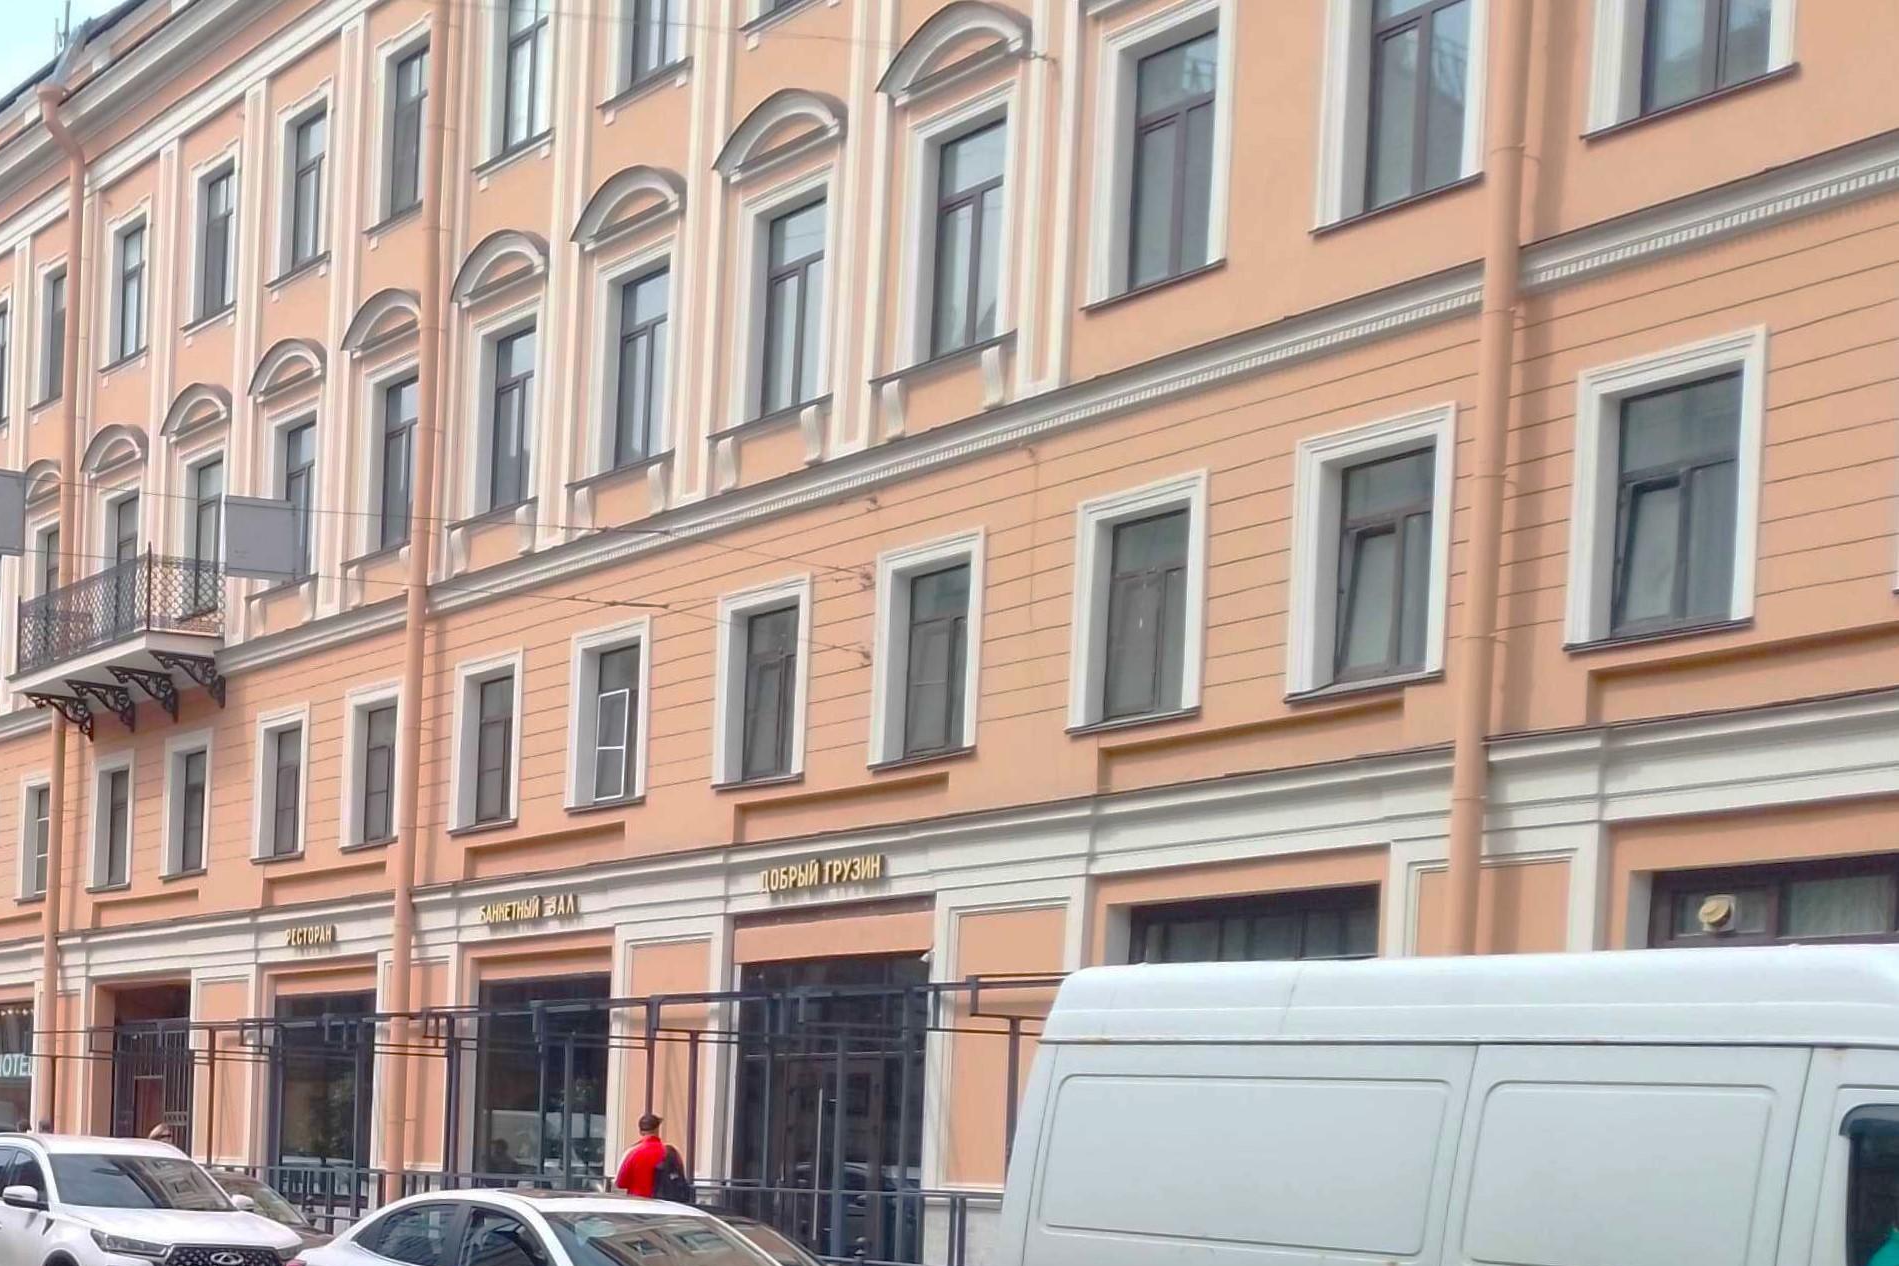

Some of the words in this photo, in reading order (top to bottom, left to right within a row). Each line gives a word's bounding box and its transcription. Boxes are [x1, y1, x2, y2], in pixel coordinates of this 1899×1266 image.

[759, 859, 820, 893] ДОБРЫЙ
[823, 854, 881, 884] ГРУЗИН
[478, 895, 540, 923] БАНКЕТНЫЙ
[545, 894, 575, 917] ЗАЛ
[285, 925, 334, 946] РЕСТОРАН
